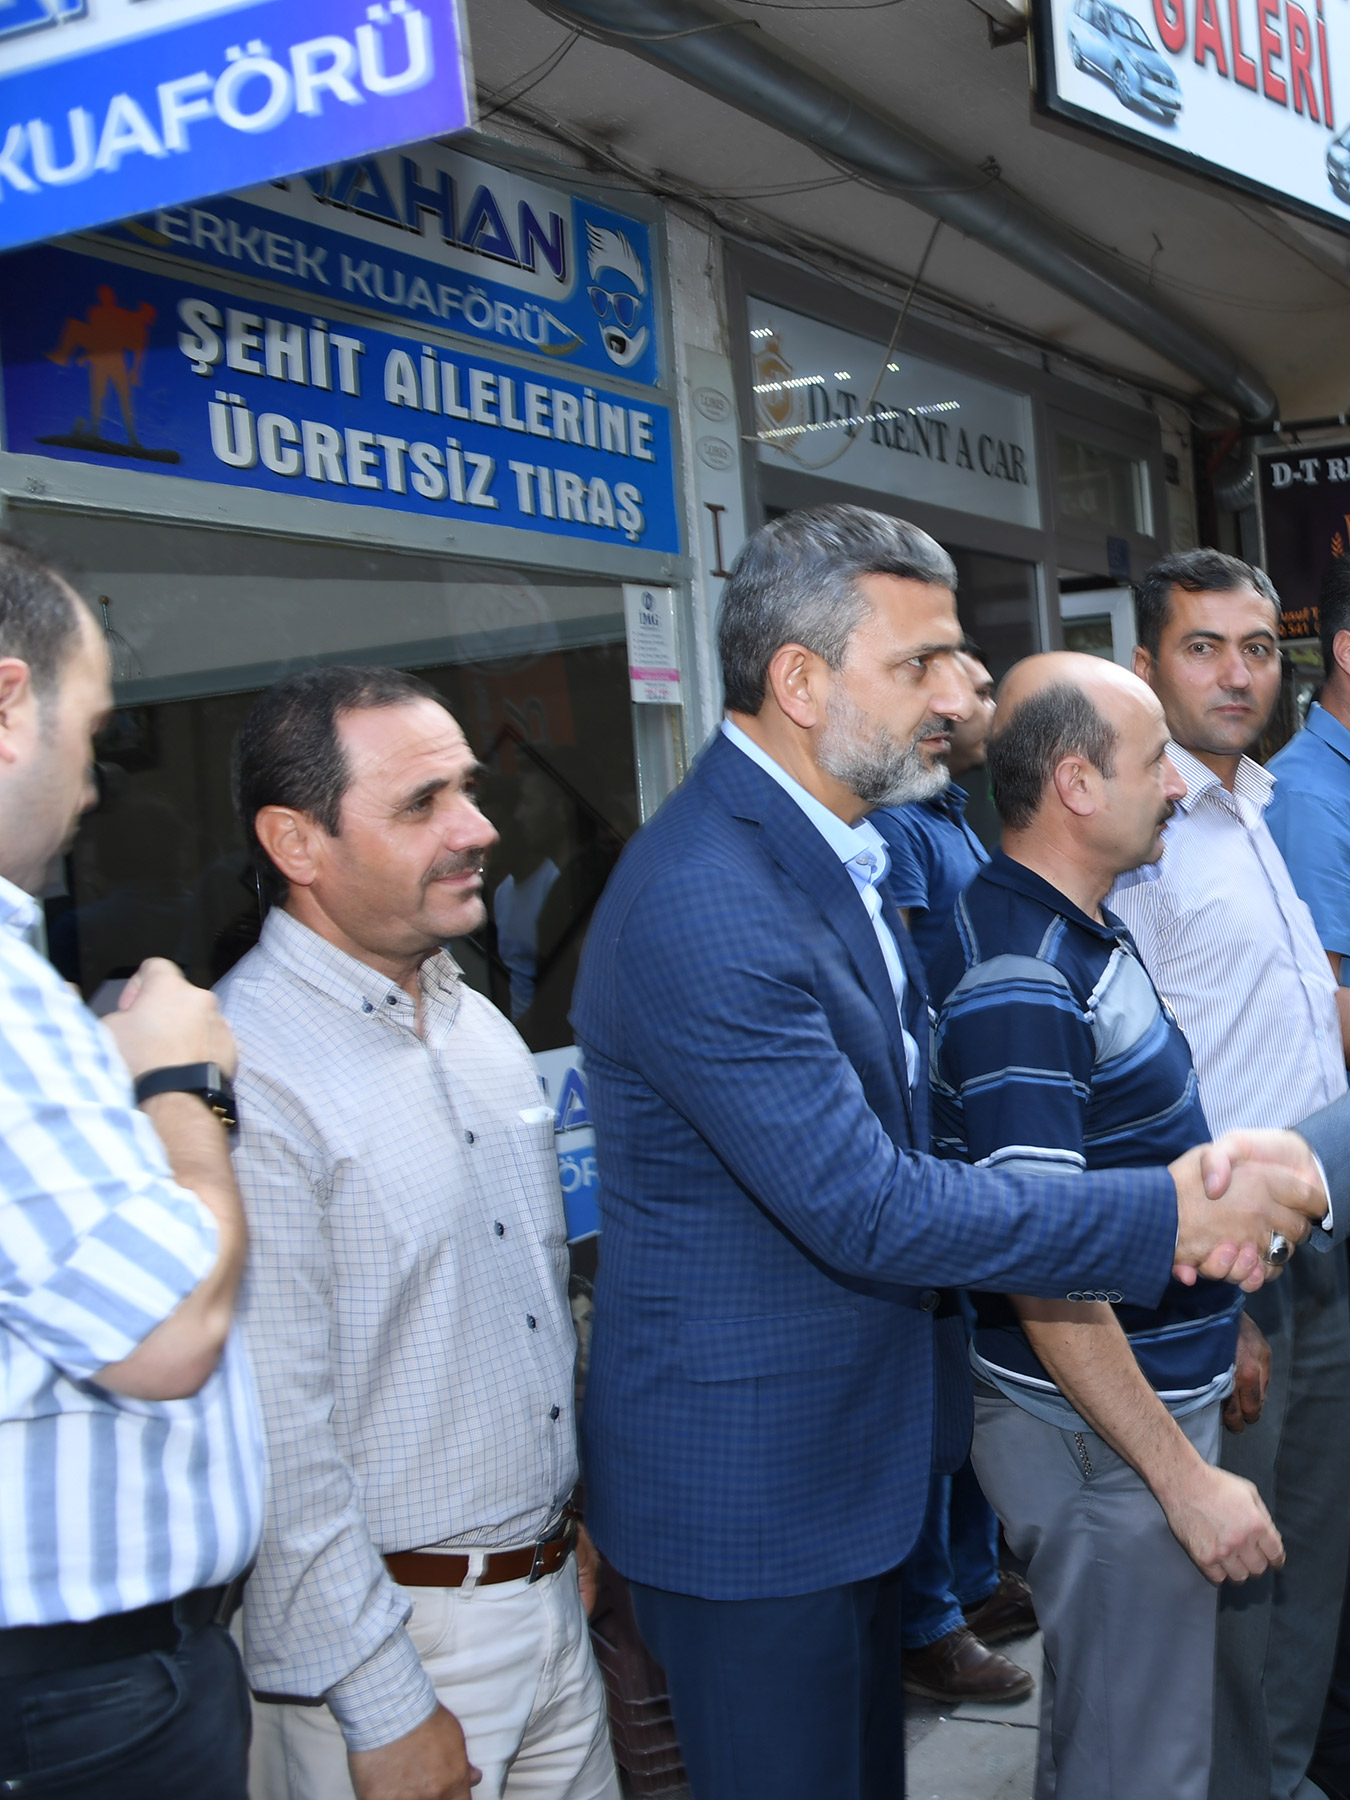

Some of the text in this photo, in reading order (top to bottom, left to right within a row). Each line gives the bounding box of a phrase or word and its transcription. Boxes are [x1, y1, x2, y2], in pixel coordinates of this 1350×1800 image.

[1151, 0, 1336, 132] GALERİ
[157, 206, 551, 346] ERKEK KUAFÖRÜ
[270, 150, 568, 284] AHAN
[177, 297, 656, 463] ŞEHİT AİLELERİNE
[868, 400, 950, 465] RENT
[955, 427, 977, 473] A
[978, 432, 1029, 486] CAR
[208, 389, 646, 543] ÜCRETSİZ TIRAŞ
[1270, 457, 1321, 489] D-T
